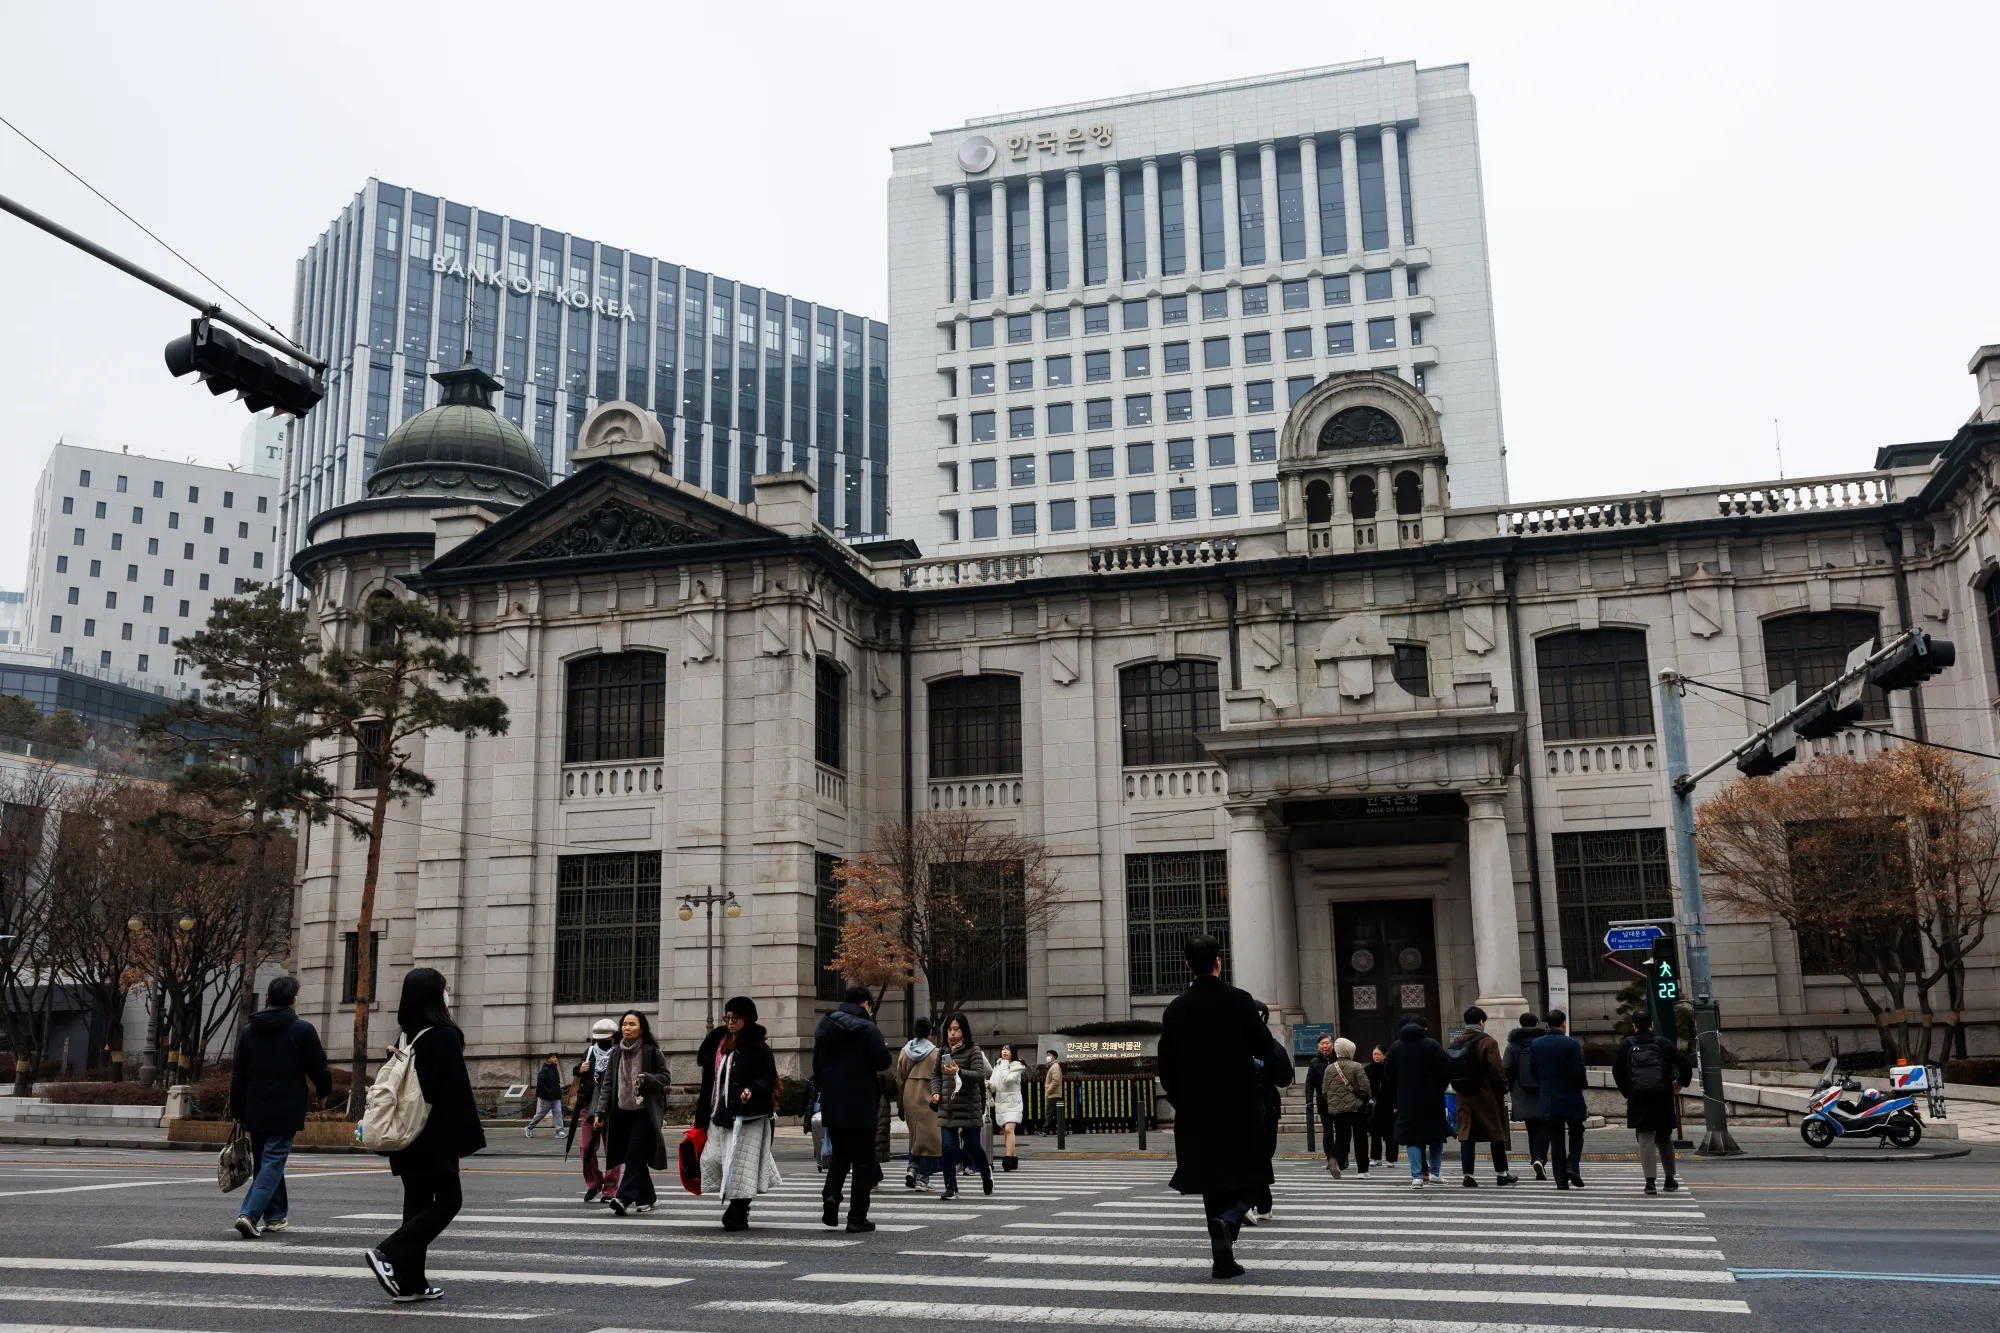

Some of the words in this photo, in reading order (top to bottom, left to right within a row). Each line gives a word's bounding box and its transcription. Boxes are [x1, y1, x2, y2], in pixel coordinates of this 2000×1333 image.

[1006, 120, 1114, 161] 한국은행
[432, 253, 504, 288] BANK
[512, 275, 545, 297] OF
[556, 285, 636, 322] KOREA
[1658, 982, 1676, 999] 22
[1066, 1042, 1098, 1051] 한국은행
[1101, 1041, 1142, 1051] 화폐박물관
